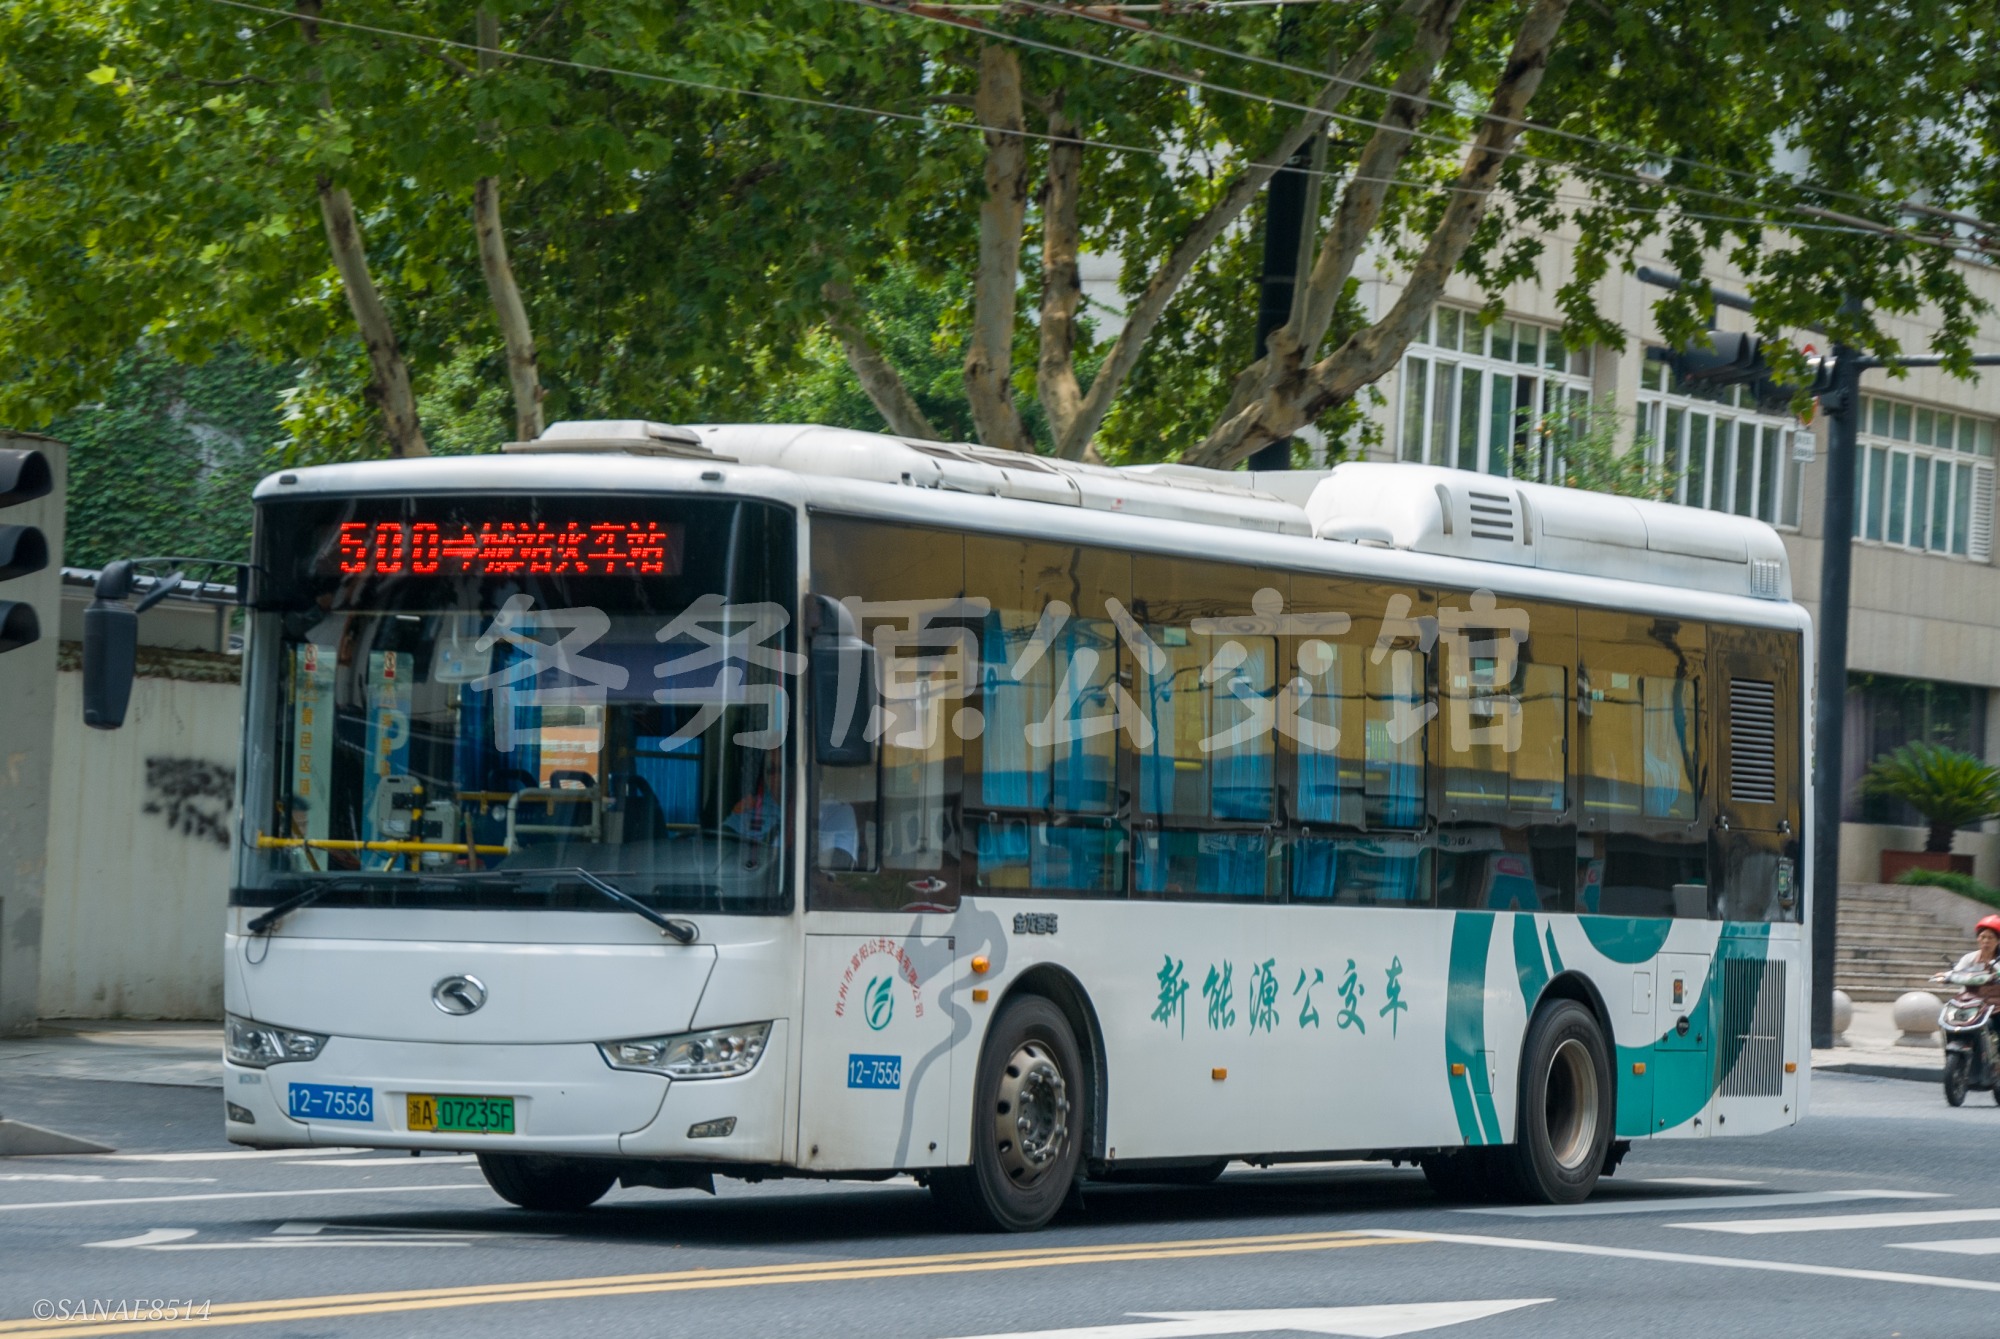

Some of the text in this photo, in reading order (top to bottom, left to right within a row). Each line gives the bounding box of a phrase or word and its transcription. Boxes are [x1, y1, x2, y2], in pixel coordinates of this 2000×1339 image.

[340, 522, 439, 573] 500
[1150, 953, 1408, 1041] 新能源公交车
[849, 1060, 900, 1085] 12-7556
[289, 1088, 370, 1117] 12-7556
